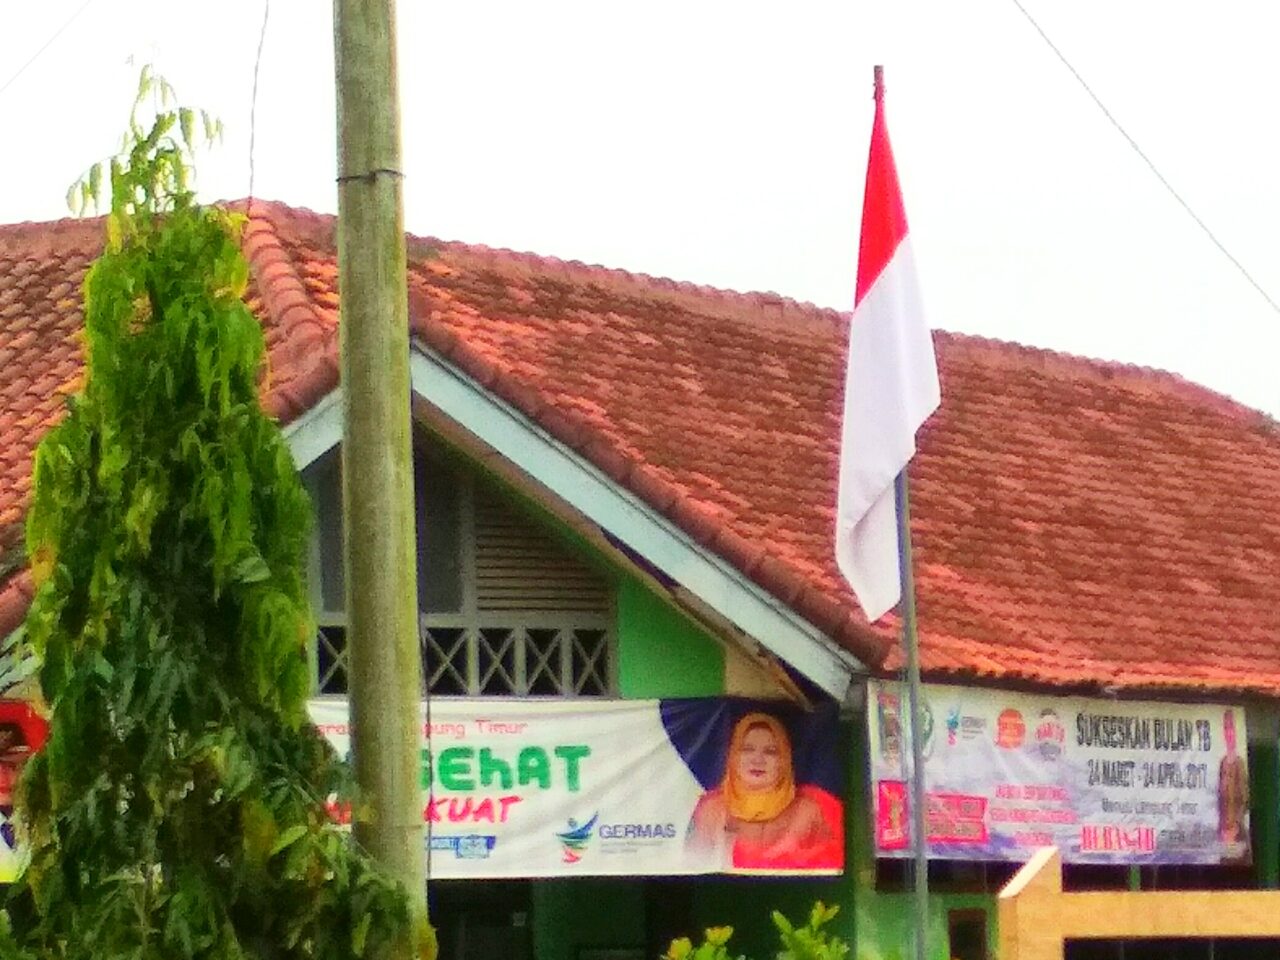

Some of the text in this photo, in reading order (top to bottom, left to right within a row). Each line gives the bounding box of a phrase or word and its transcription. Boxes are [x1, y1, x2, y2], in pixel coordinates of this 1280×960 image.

[475, 719, 528, 735] Timur
[424, 795, 523, 823] KUAT
[599, 823, 676, 839] GERMAS
